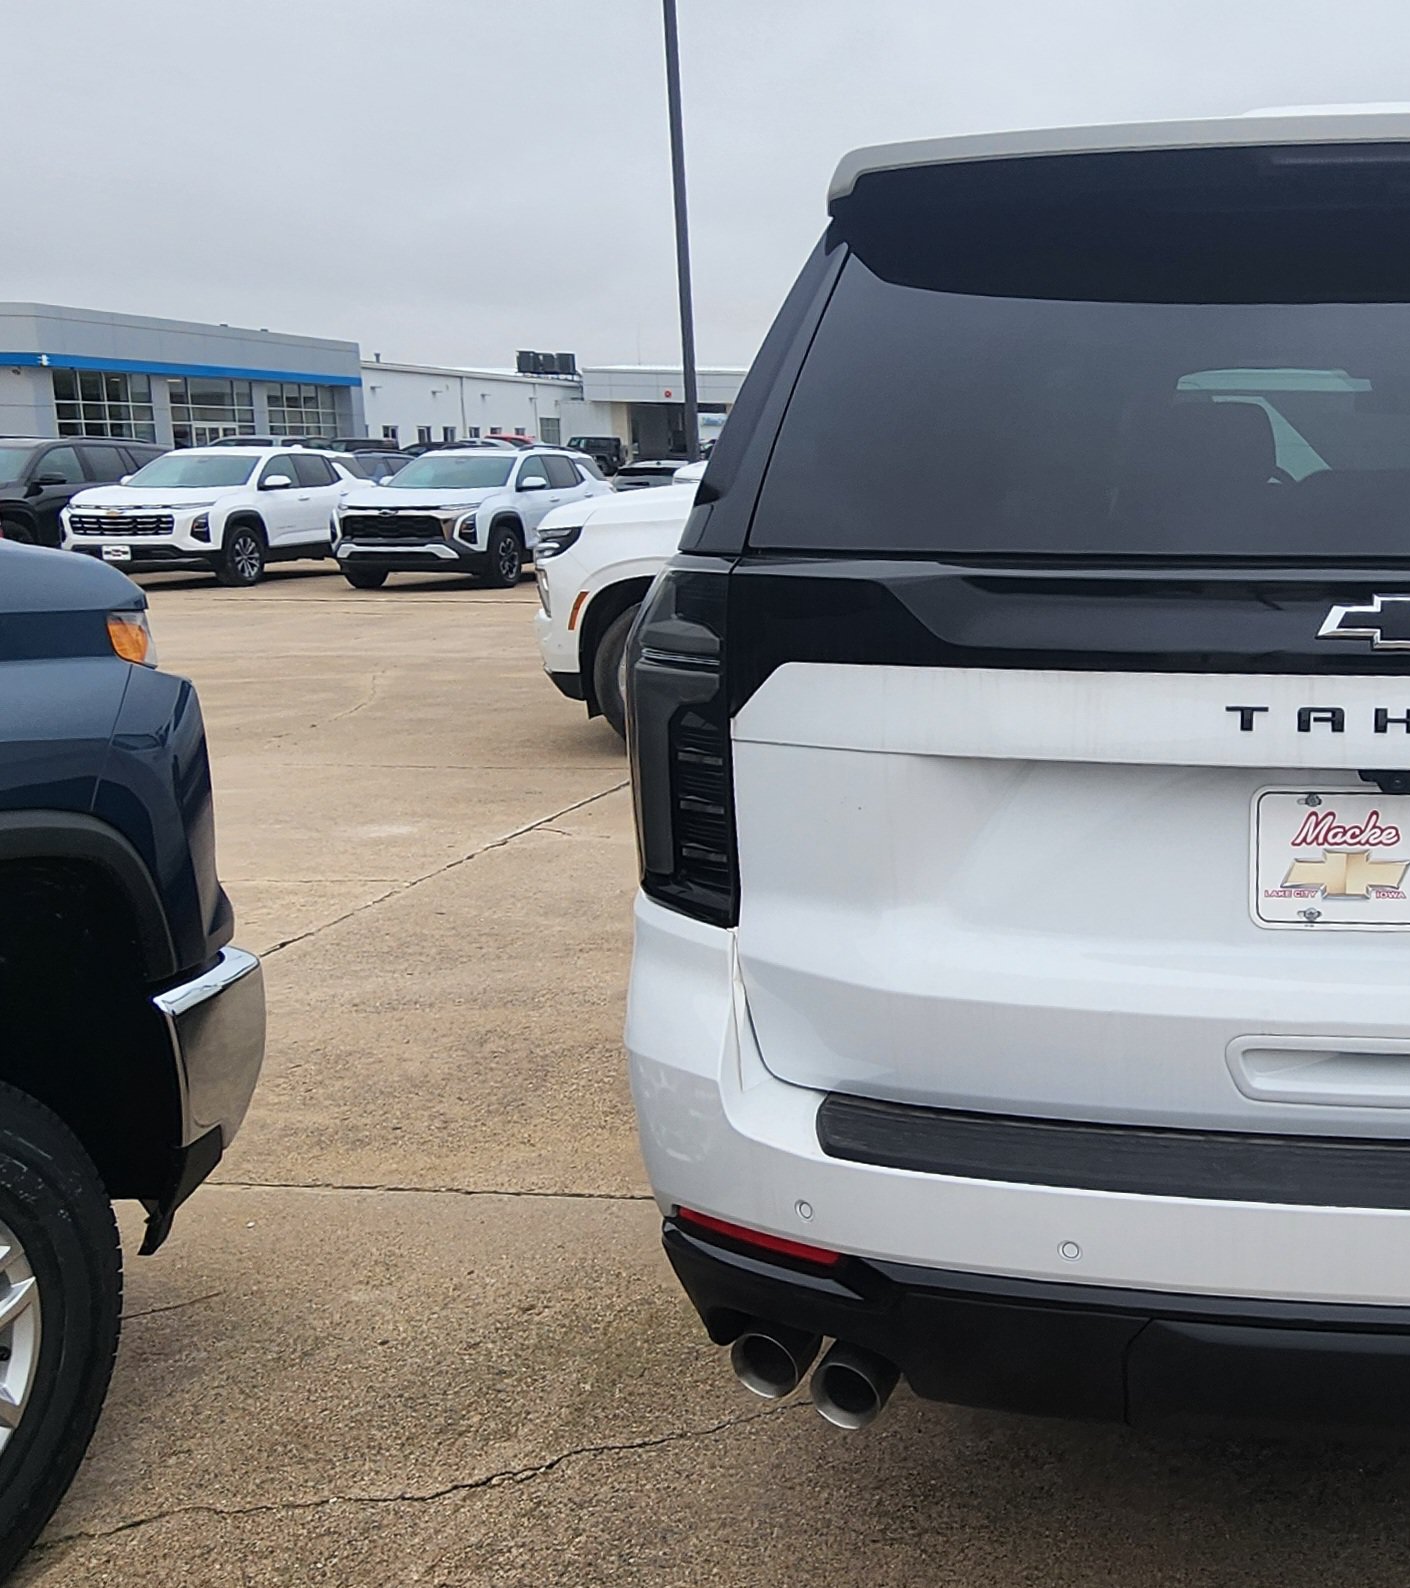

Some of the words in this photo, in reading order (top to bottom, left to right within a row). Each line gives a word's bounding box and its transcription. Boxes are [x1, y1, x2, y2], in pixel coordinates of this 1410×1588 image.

[1290, 809, 1401, 847] Macke
[1264, 889, 1292, 898] LAKE
[1293, 889, 1318, 898] CITY
[1375, 890, 1407, 899] IOWA
